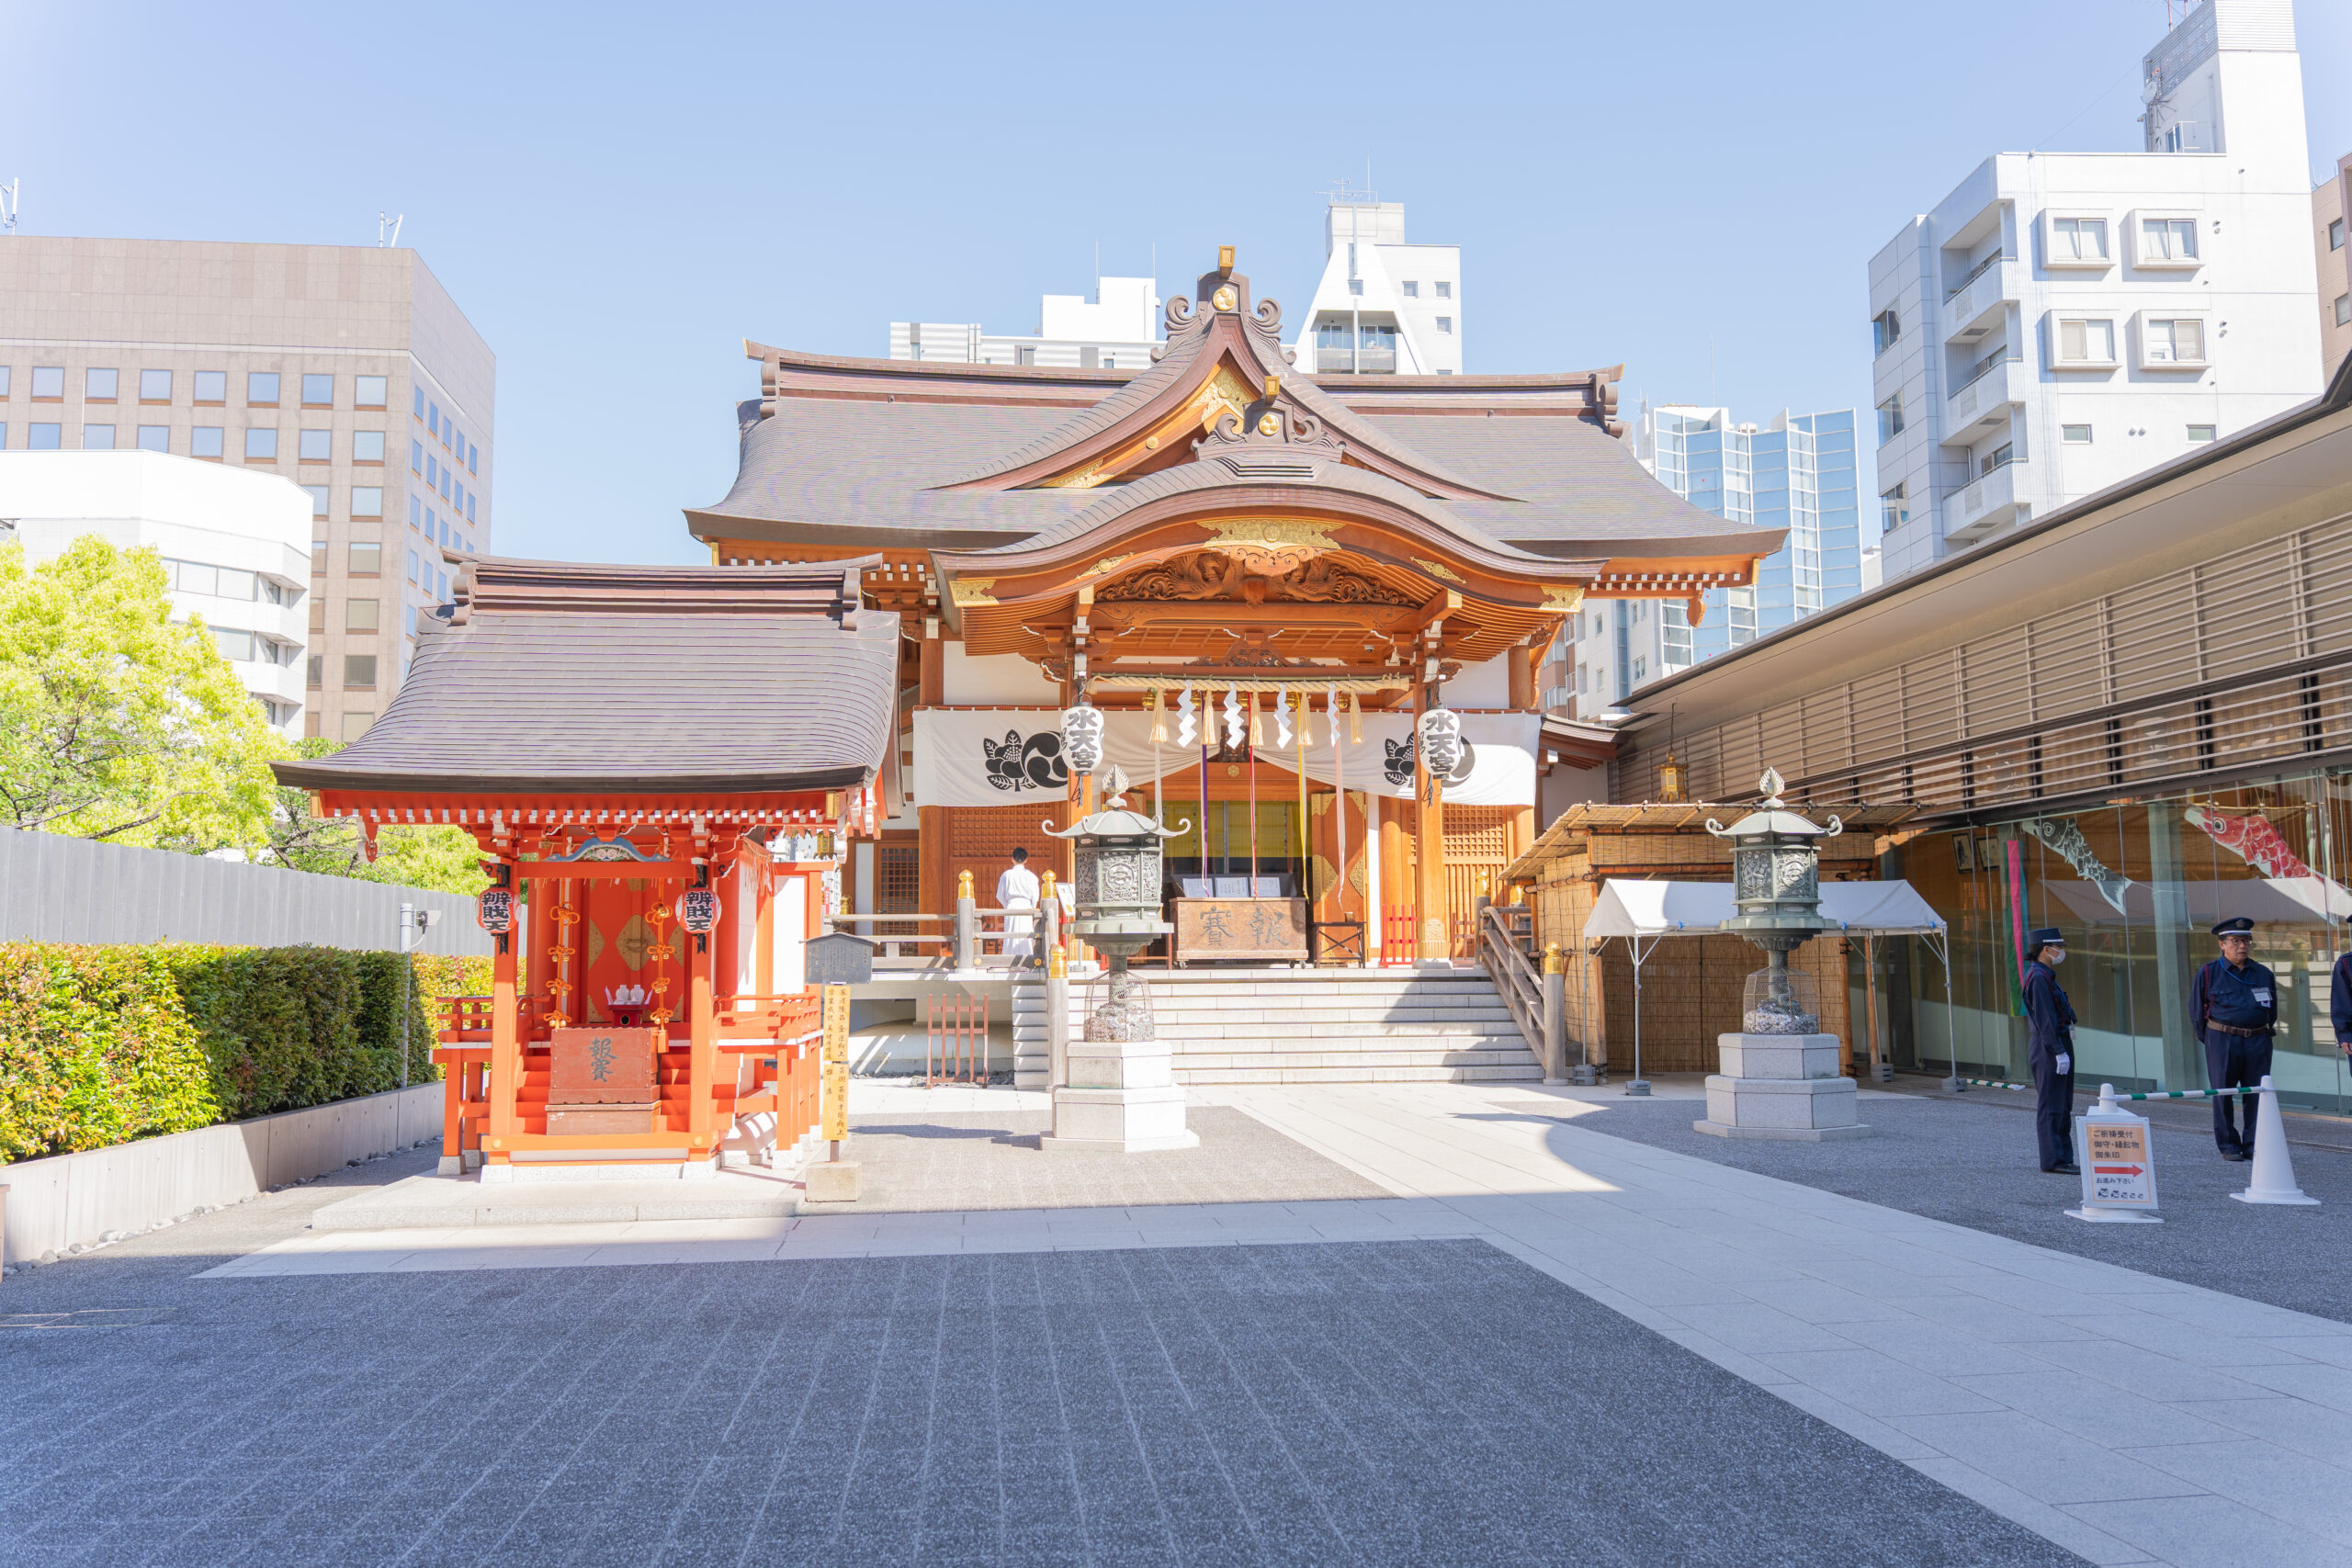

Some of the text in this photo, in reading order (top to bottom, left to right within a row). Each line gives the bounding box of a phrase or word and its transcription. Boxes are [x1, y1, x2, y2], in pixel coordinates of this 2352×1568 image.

[1068, 709, 1098, 768] 水天宮
[1425, 712, 1456, 773] 水天宮
